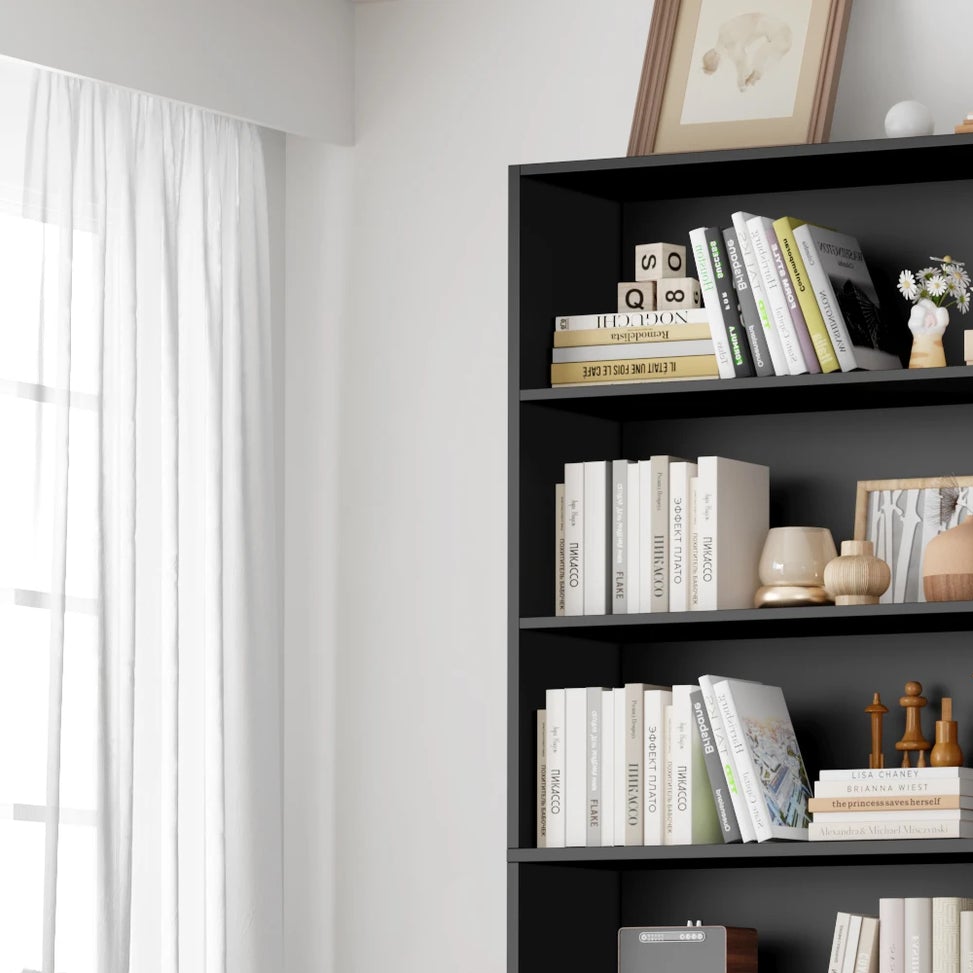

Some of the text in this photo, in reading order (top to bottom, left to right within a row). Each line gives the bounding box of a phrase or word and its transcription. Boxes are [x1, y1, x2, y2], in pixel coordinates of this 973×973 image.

[624, 288, 645, 310] Q
[596, 310, 688, 329] NOGUCHI
[610, 330, 670, 340] Remodelista
[582, 361, 677, 380] IL ÉTAIT UNE FOIS LE CAFÉ
[673, 497, 683, 585] ЭФФЕКТ ПЛАТО
[702, 536, 713, 583] ПИКАССО
[568, 542, 579, 588] ПИКАССО
[653, 534, 665, 599] ПИКАССО
[615, 570, 625, 600] FLAKE
[648, 725, 657, 814] ЭФФЕКТ ПЛАТО
[677, 765, 687, 812] ПИКАССО
[846, 783, 929, 793] BRIANNA WIEST
[851, 769, 920, 780] LISA CHANEY
[550, 768, 560, 815] ПИКАССО
[627, 762, 639, 827] ПИКАССО
[589, 799, 599, 828] FLAKE
